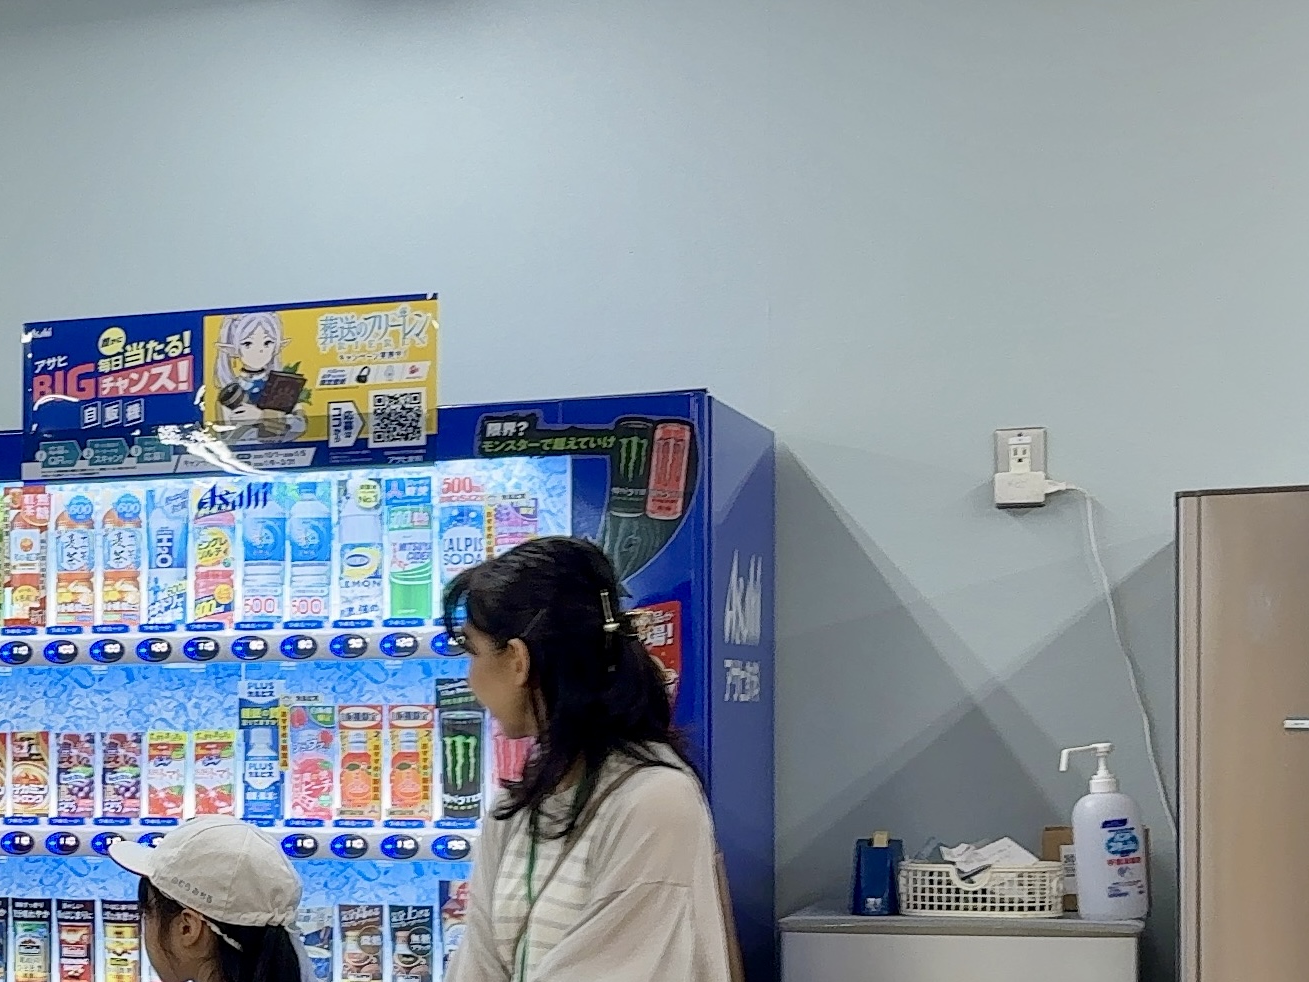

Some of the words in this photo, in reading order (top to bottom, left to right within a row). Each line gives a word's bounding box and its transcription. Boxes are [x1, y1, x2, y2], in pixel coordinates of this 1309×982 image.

[34, 355, 69, 373] アサヒ
[33, 362, 96, 402] BIG
[100, 359, 190, 397] チャンス!
[486, 420, 530, 438] 限界?
[481, 435, 617, 453] モンスターで超えていけ
[196, 481, 274, 512] Asahi
[247, 682, 275, 690] PLUS
